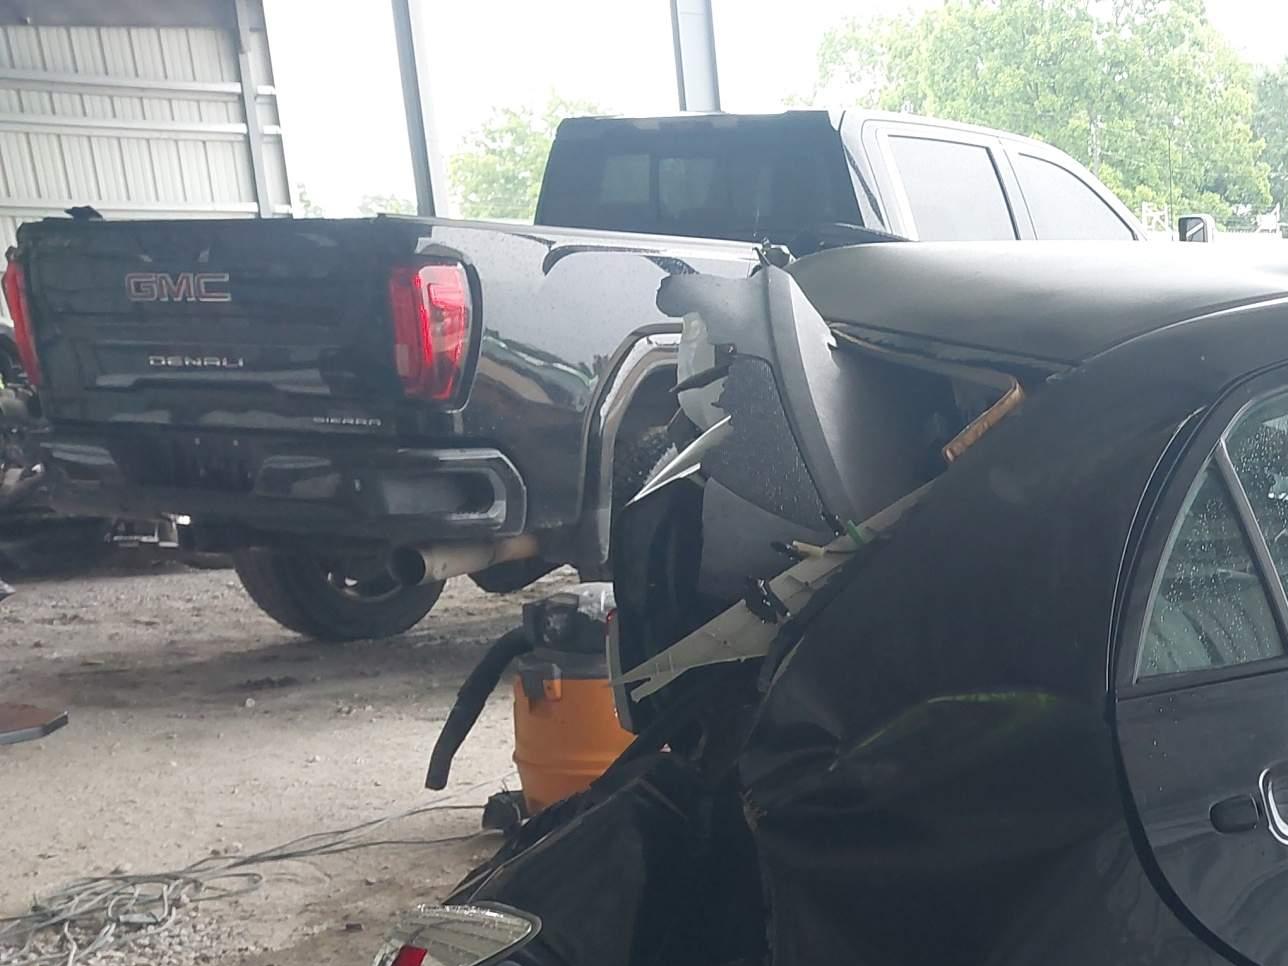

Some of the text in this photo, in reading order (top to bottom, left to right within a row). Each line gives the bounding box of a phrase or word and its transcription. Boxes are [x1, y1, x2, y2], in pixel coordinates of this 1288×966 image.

[125, 272, 232, 302] GMC
[149, 355, 243, 368] DENALI
[312, 416, 382, 427] SIERRA
